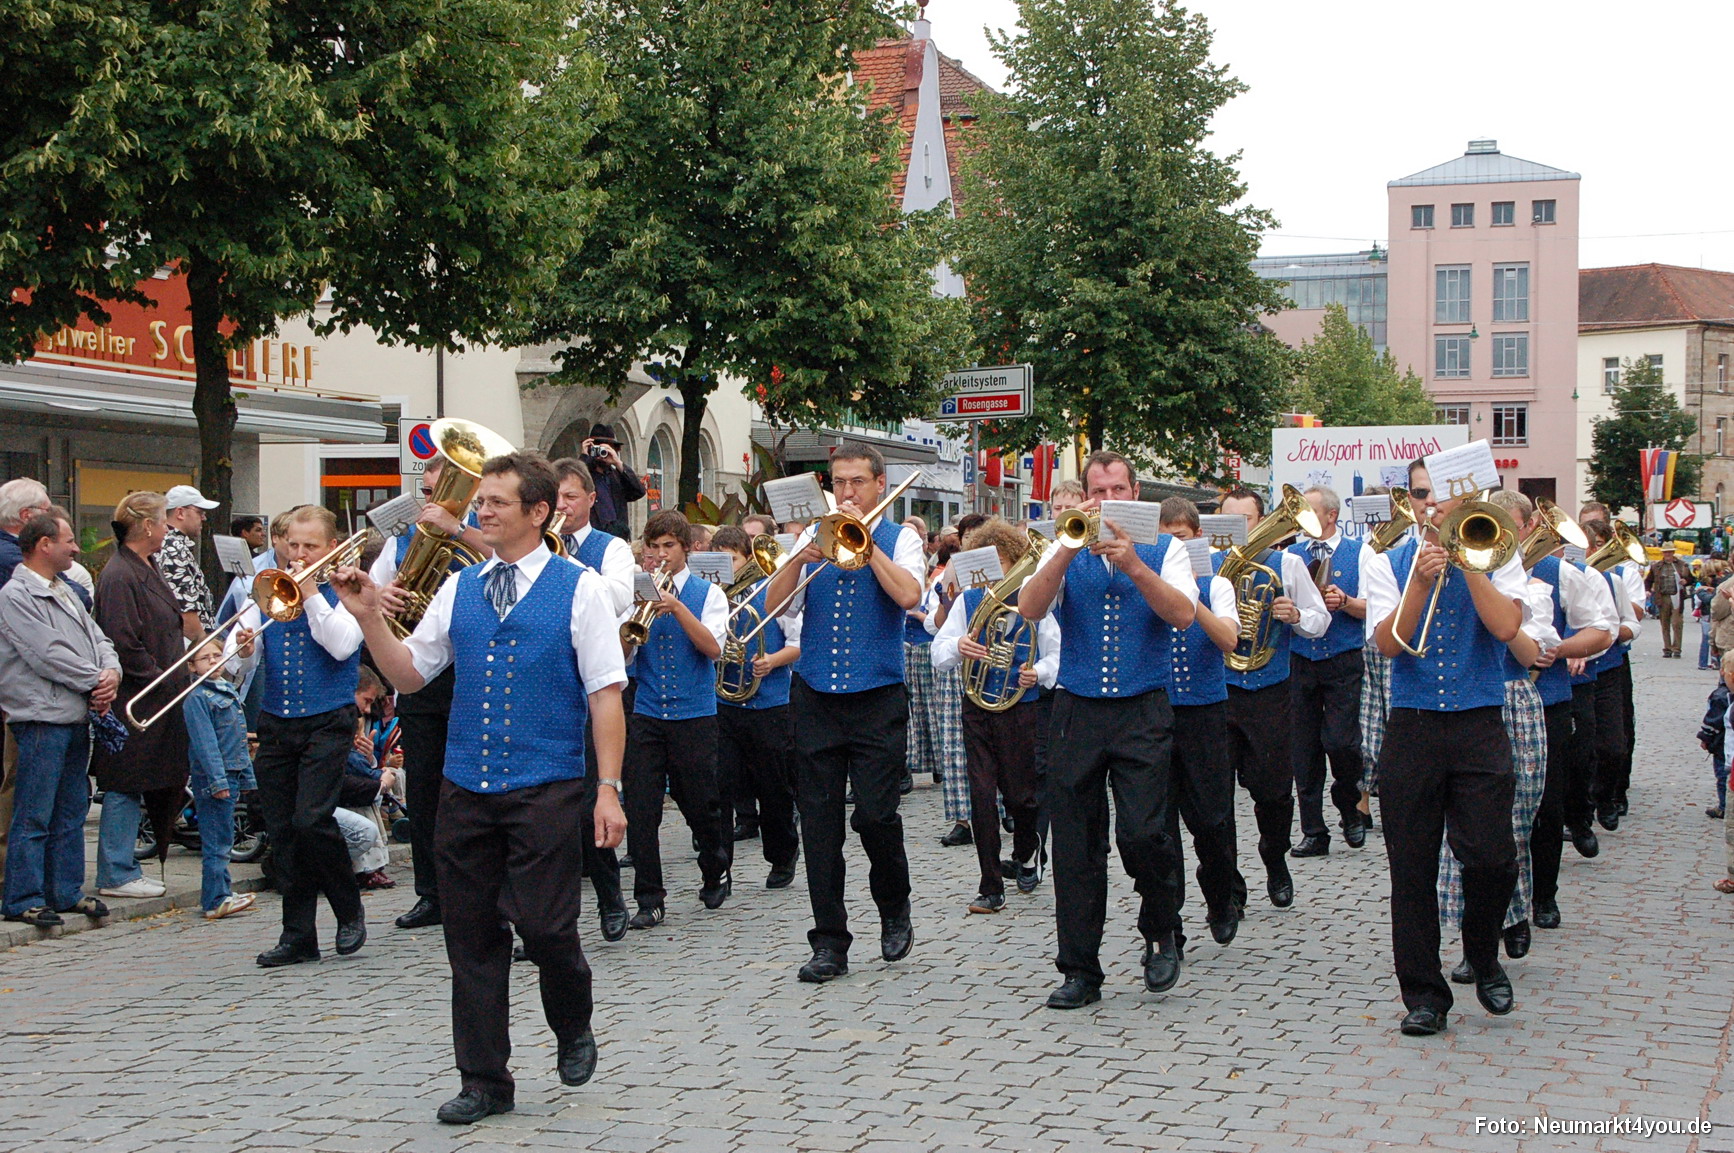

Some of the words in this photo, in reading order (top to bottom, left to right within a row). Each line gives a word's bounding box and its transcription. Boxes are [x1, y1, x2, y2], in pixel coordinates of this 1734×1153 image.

[149, 320, 320, 380] SCLIERF
[962, 399, 1008, 412] Rosengasse
[1287, 438, 1364, 466] Schulsport
[1369, 438, 1386, 460] im
[1387, 437, 1442, 461] Wandel
